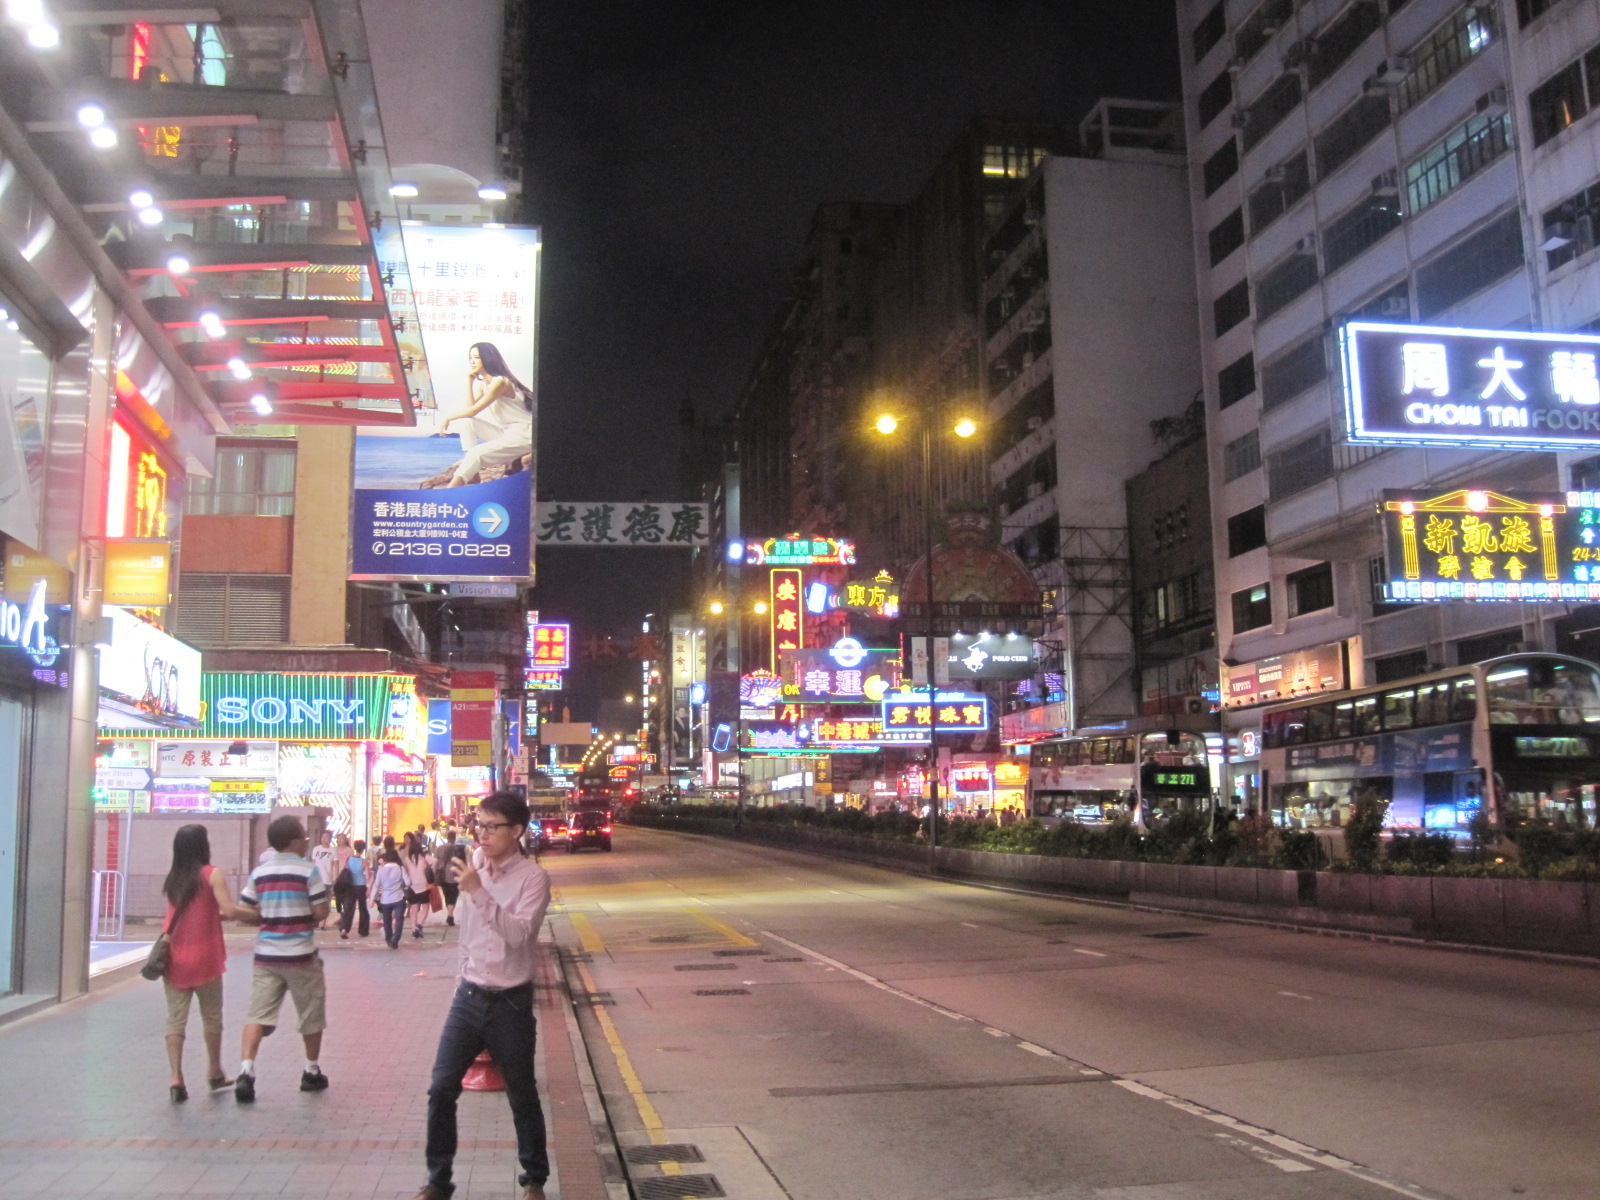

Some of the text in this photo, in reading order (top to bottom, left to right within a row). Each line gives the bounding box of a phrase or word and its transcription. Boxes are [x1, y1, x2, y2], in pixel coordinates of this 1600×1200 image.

[1402, 342, 1600, 405] 周大福
[1406, 402, 1600, 431] CHOW TAI FOOK
[373, 502, 469, 518] 香港展銷中心
[373, 521, 469, 530] www.countrygarden.cn
[1424, 514, 1537, 555] 新凱旋
[389, 542, 511, 557] 2136 0828
[804, 670, 861, 695] 幸運
[452, 703, 466, 711] A21
[819, 721, 870, 740] 中港城
[1180, 773, 1196, 785] 271
